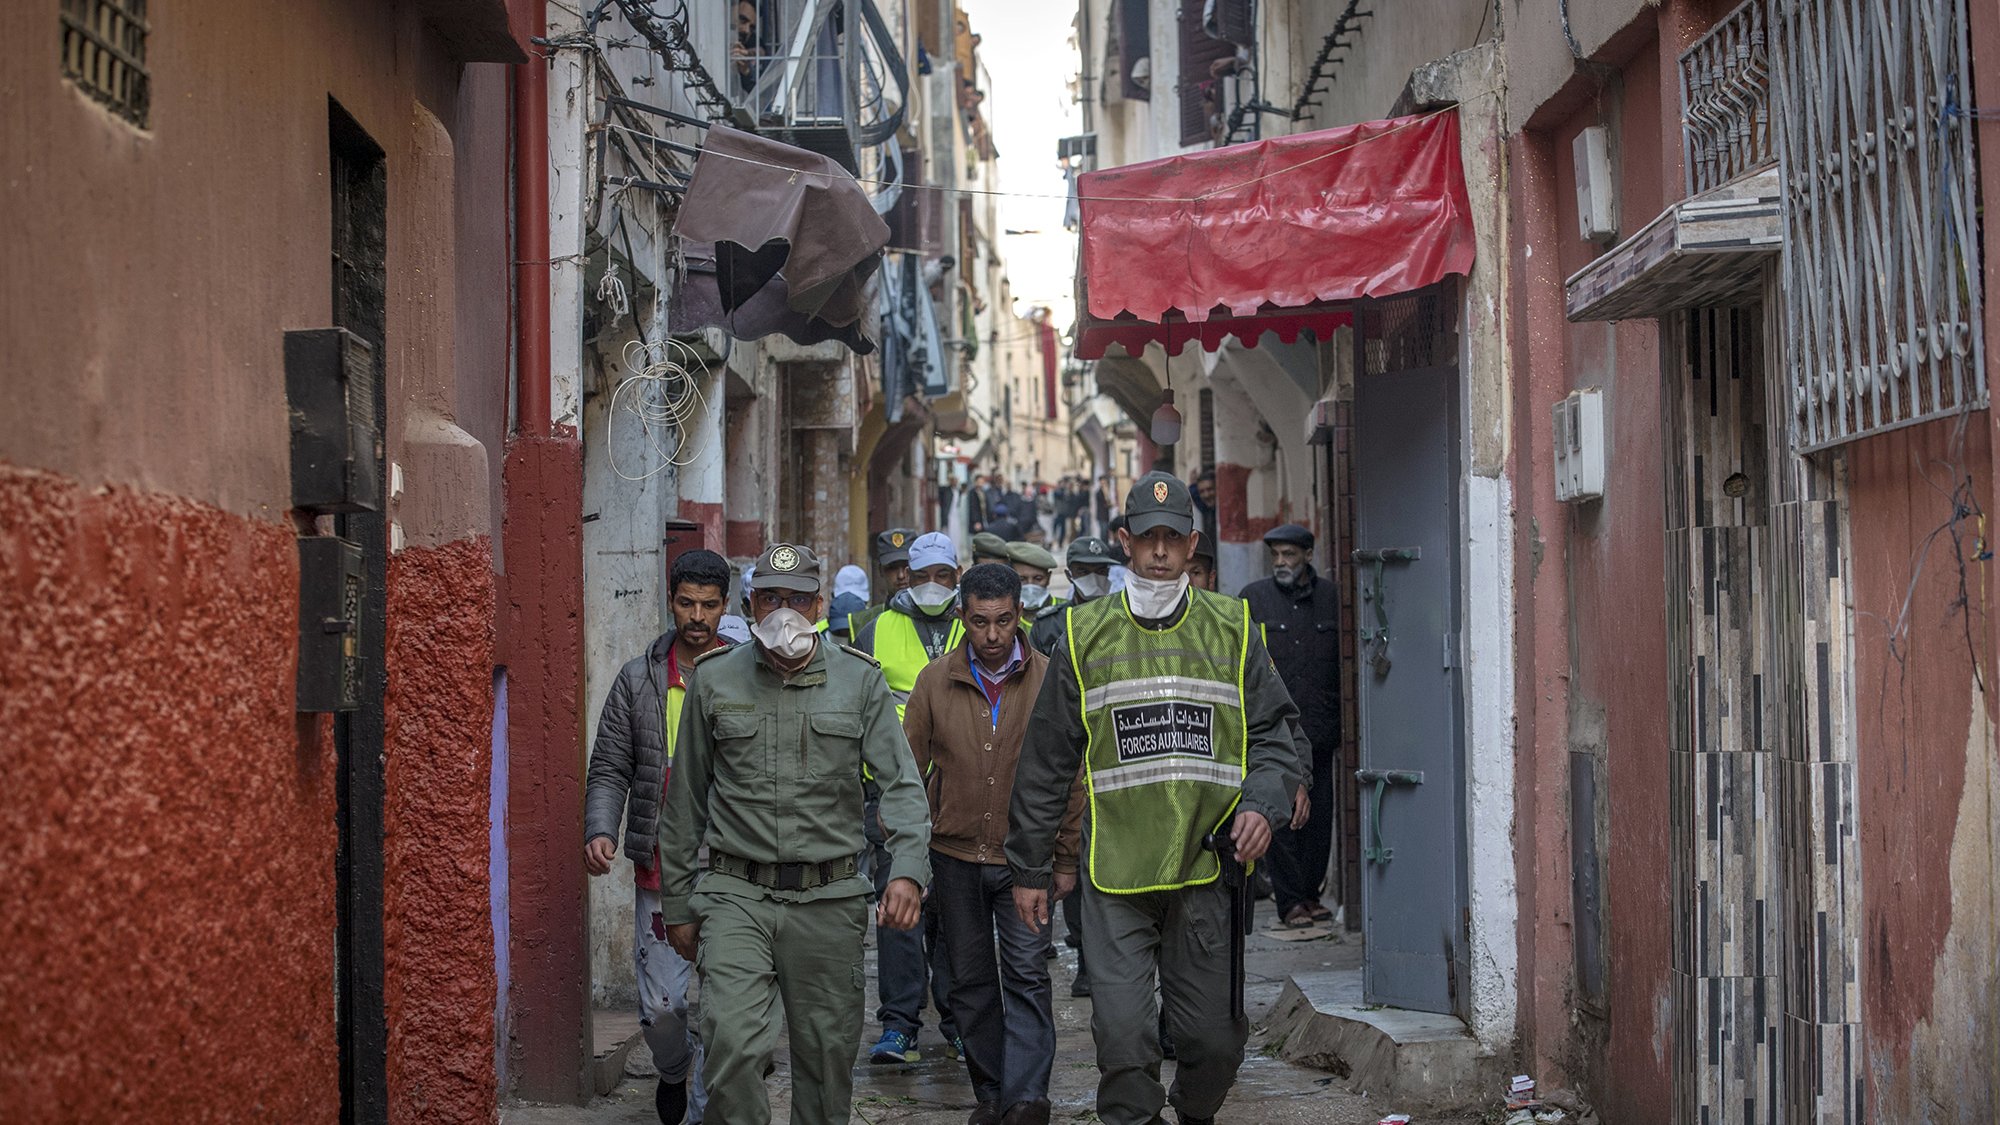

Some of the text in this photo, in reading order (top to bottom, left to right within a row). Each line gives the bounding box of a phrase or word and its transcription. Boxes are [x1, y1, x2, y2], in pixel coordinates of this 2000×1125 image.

[1118, 708, 1208, 732] القوات المساعدة
[1121, 731, 1209, 756] FORCES AUXILIAIRES
